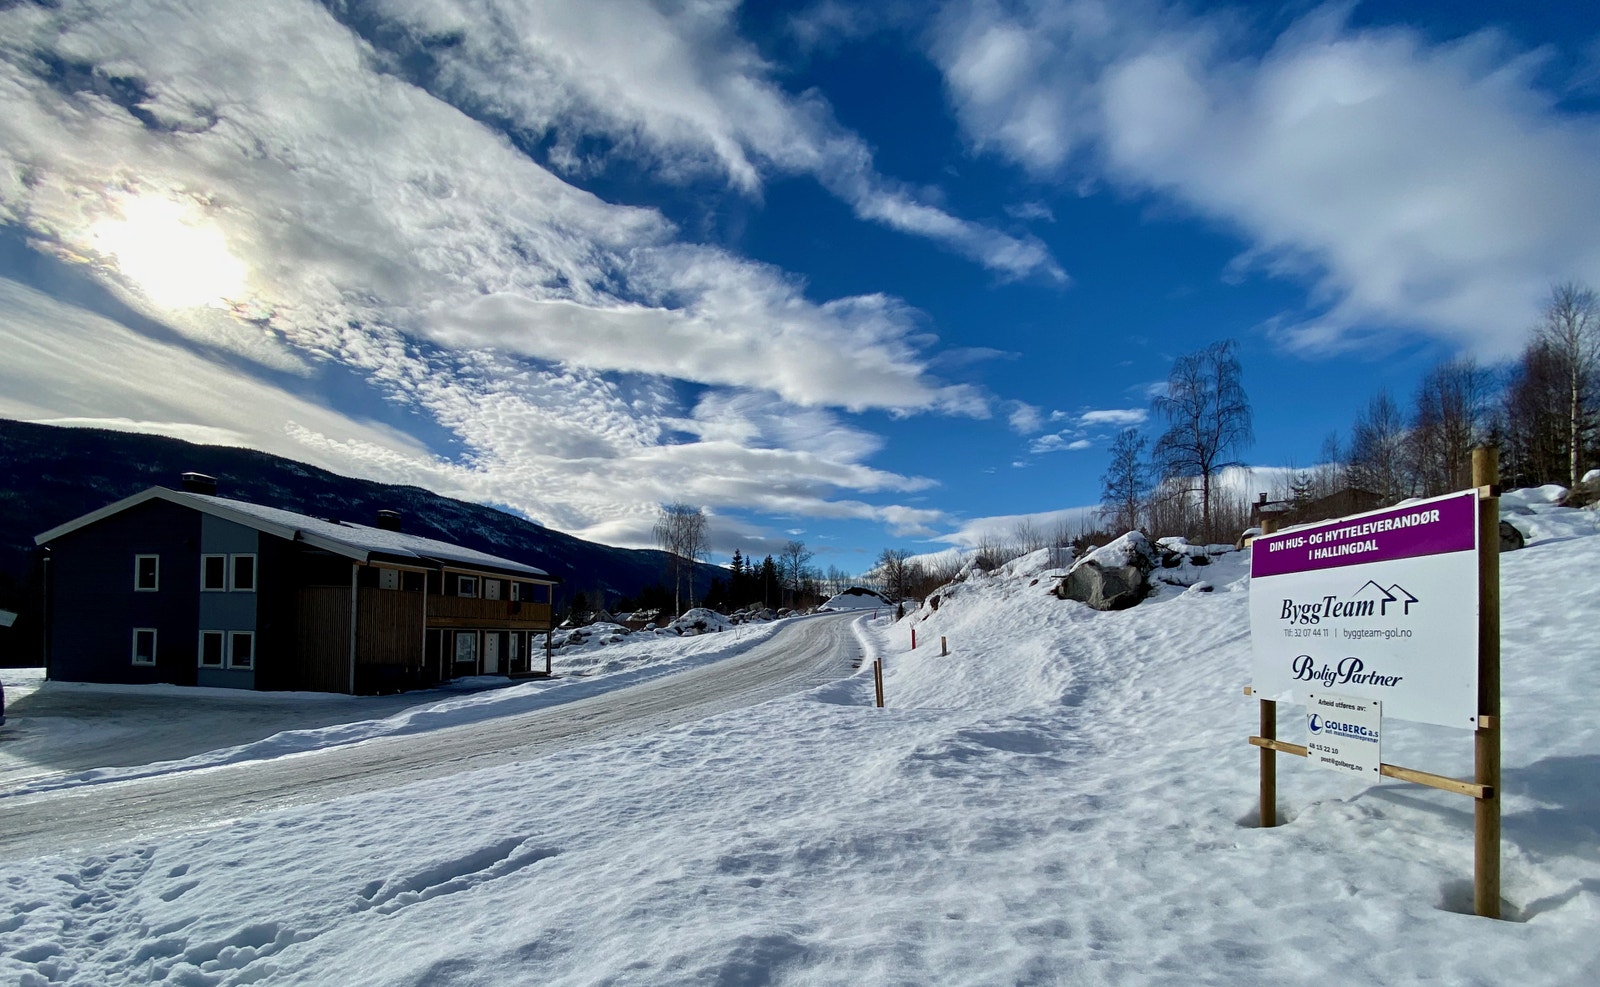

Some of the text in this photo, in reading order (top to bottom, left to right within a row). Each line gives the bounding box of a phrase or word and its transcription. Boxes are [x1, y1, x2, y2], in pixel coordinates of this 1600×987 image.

[1270, 509, 1440, 552] DIN HUS- OG HYTTELEVERANDØR
[1314, 539, 1378, 560] HALLINGDAL
[1280, 596, 1374, 624] ByggTeam
[1294, 628, 1301, 637] 32
[1303, 628, 1311, 637] 07
[1312, 628, 1321, 637] 44
[1322, 628, 1329, 637] 11
[1343, 628, 1412, 640] byggteam-gol.no
[1292, 654, 1403, 687] BoligPartner
[1325, 720, 1367, 736] GOLBERG
[1320, 756, 1362, 772] post@golberg.no
